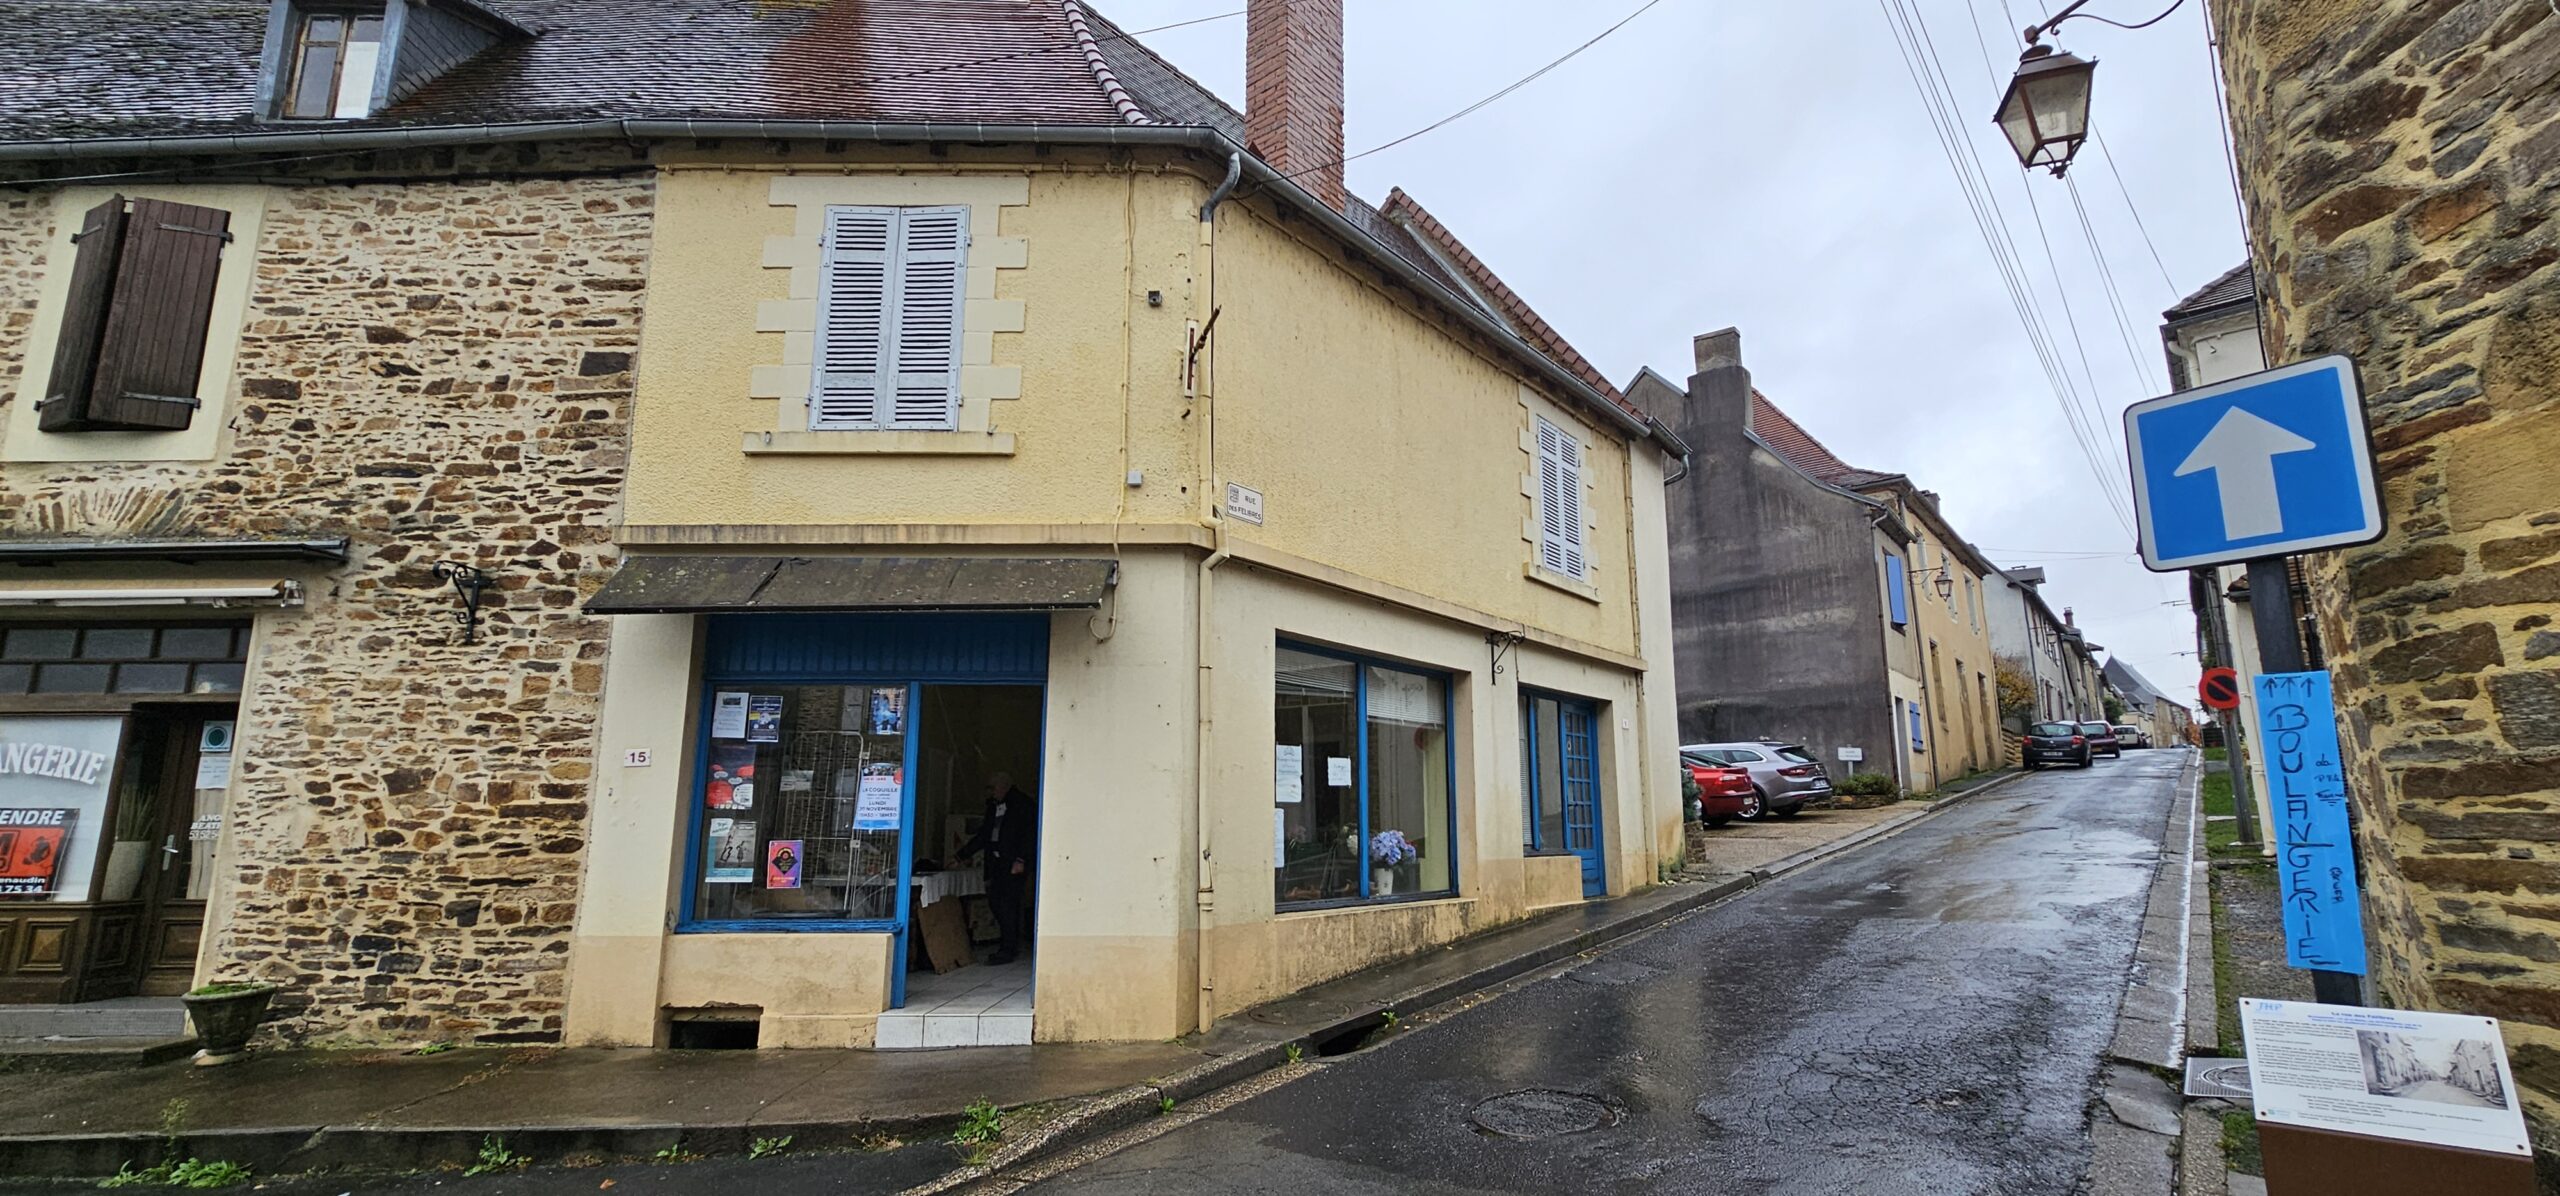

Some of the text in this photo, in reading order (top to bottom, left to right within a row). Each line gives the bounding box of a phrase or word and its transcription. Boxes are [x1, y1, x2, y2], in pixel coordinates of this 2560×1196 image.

[1245, 496, 1256, 505] RUE
[629, 751, 647, 764] 15
[2267, 703, 2323, 960] BOULANGERIE
